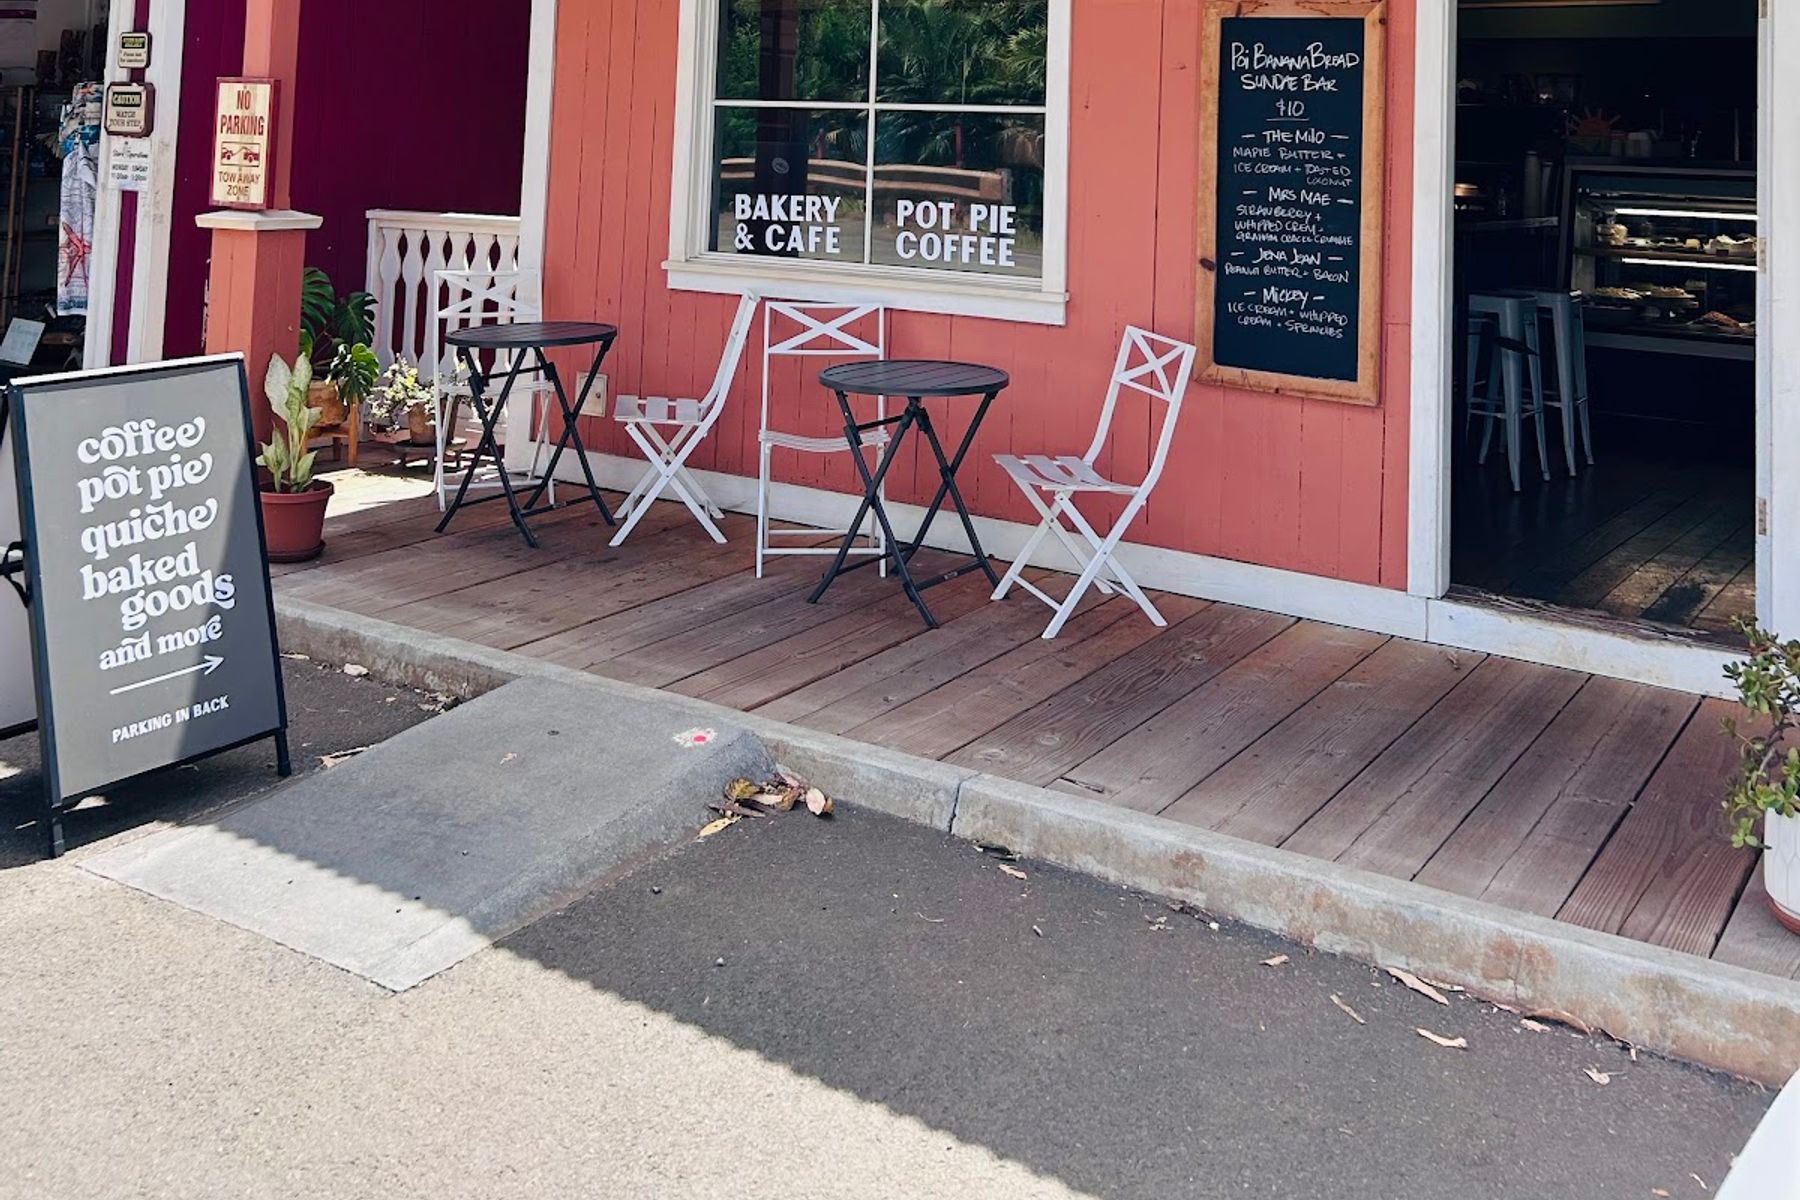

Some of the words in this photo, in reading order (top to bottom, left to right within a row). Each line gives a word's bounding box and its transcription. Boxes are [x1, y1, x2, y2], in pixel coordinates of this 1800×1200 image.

[1254, 43, 1311, 71] BANANA
[1306, 42, 1360, 69] BREAD
[1301, 74, 1338, 91] BAR
[112, 94, 141, 105] CAUTION
[236, 90, 252, 110] NO
[1275, 98, 1304, 117] $10
[220, 115, 265, 136] PARKING
[1262, 129, 1294, 144] THE
[1278, 147, 1334, 160] BUTTER
[218, 171, 236, 183] TOW
[238, 173, 260, 185] AWAY
[1234, 162, 1252, 174] ICE
[1254, 162, 1292, 174] CREAM
[226, 185, 249, 197] ZONE
[1268, 186, 1297, 202] MRS
[1300, 189, 1331, 206] MAE
[735, 193, 841, 223] BAKERY
[896, 199, 955, 230] POT
[970, 203, 1017, 235] PIE
[734, 223, 754, 250] &
[765, 224, 840, 254] CAFE
[895, 231, 1016, 267] COFFEE
[1263, 264, 1302, 279] BUTTER
[1313, 268, 1349, 283] BACON
[1228, 302, 1246, 313] ICE
[1247, 303, 1287, 317] CREAM
[1299, 309, 1348, 326] WHIPPED
[77, 416, 205, 464] coffee
[77, 465, 142, 513] pot
[148, 452, 213, 501] pie
[80, 498, 218, 560] quiche
[80, 542, 200, 600] baked
[120, 570, 235, 630] goods
[99, 634, 152, 670] and
[156, 614, 223, 655] more
[112, 712, 172, 743] PARKING
[175, 707, 190, 724] IN
[193, 695, 230, 720] BACK
